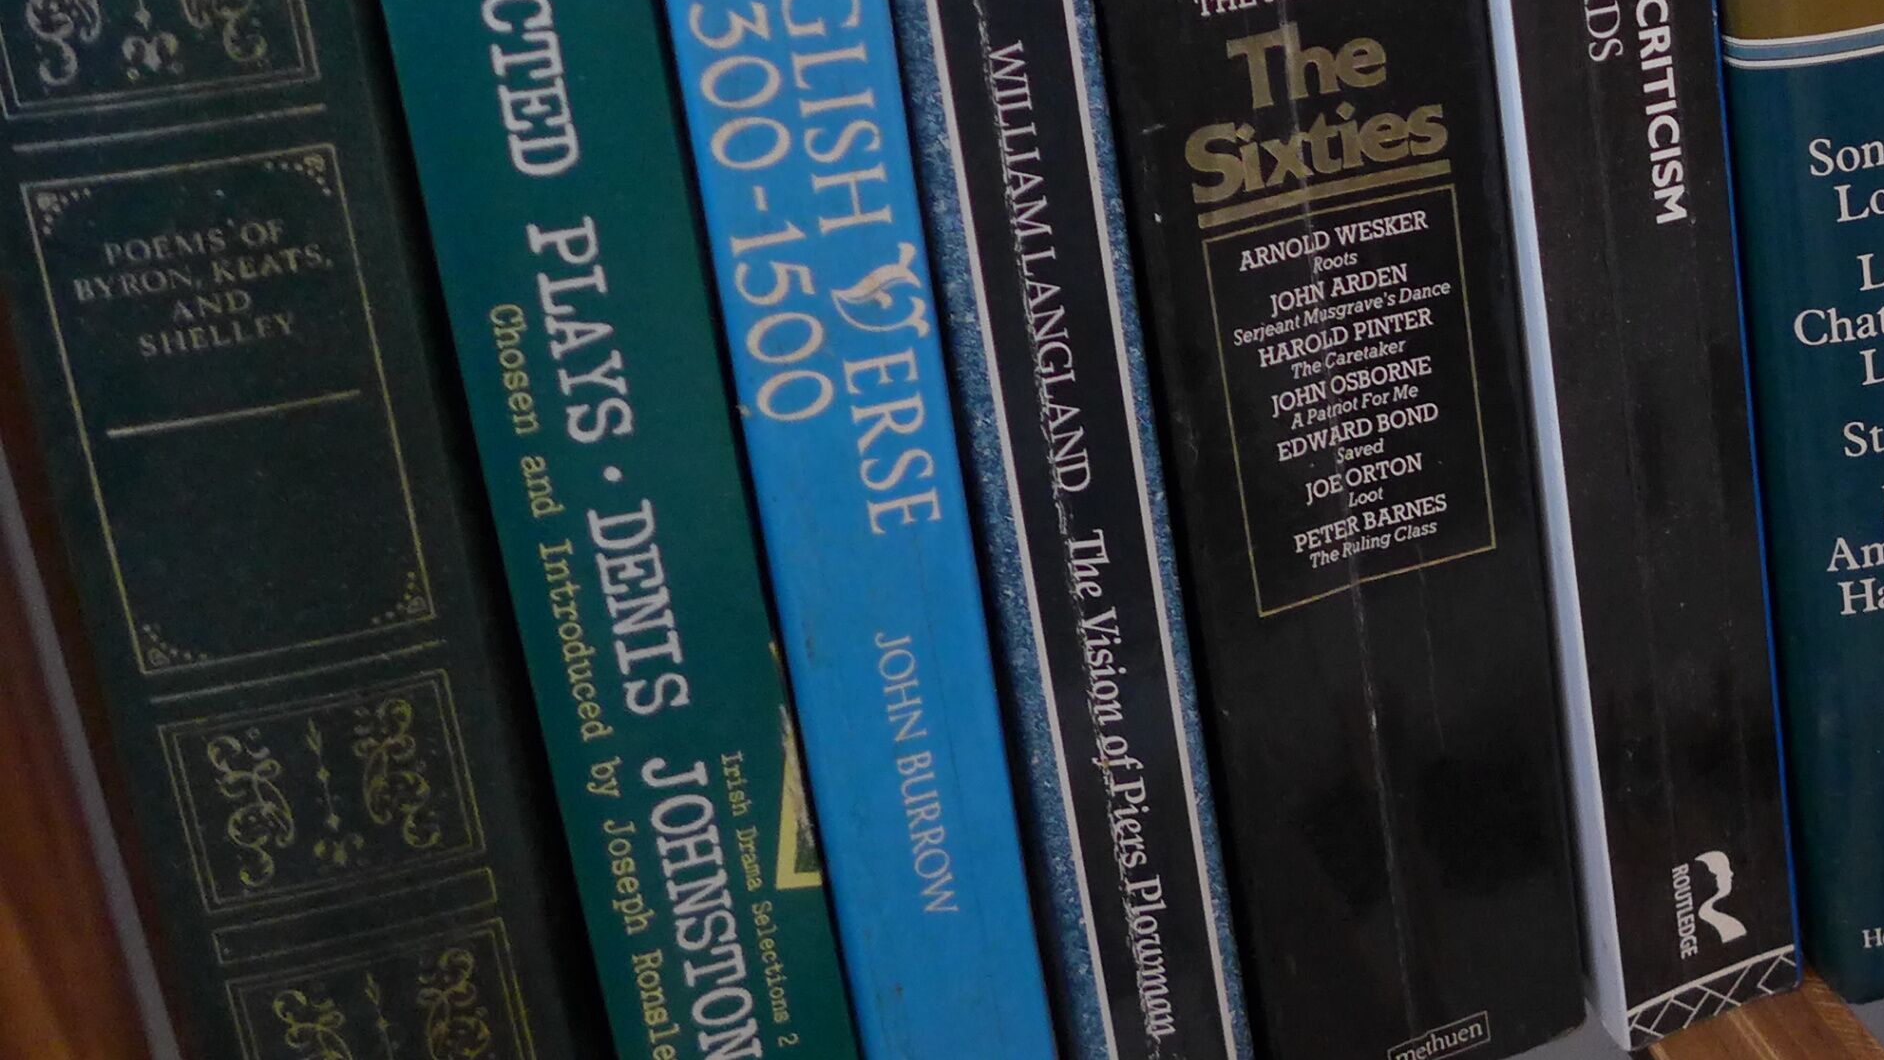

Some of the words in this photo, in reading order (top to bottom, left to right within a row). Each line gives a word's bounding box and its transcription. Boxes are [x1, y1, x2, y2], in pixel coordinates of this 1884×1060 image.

[1226, 21, 1387, 110] The
[987, 39, 1054, 238] WILLIAM
[1185, 102, 1448, 204] Sixties
[104, 227, 226, 266] POEMS
[240, 218, 285, 246] OF
[212, 243, 334, 285] KEATS,
[1239, 230, 1330, 271] ARNOLD
[1335, 210, 1429, 248] WESKER
[1312, 251, 1358, 274] Roots
[173, 289, 251, 323] AND
[1233, 316, 1301, 347] Serjeant
[1303, 290, 1397, 327] Musgrave's
[1399, 281, 1452, 304] Dance
[1270, 284, 1326, 317] JOHN
[1330, 263, 1409, 297] ARDEN
[139, 312, 294, 358] SHELLEY
[1258, 328, 1349, 368] HAROLD
[1354, 307, 1434, 341] PINTER
[1291, 360, 1322, 380] The
[1325, 339, 1406, 369] Caretaker
[489, 303, 541, 437] Chosen
[830, 241, 942, 536] VERSE
[1020, 251, 1092, 494] LANGLAND
[1271, 384, 1327, 417] JOHN
[1330, 356, 1432, 397] OSBORNE
[1277, 417, 1373, 461] EDWARD
[1377, 402, 1439, 434] BOND
[1291, 413, 1304, 430] A
[1307, 399, 1358, 426] Patriot
[1361, 391, 1389, 411] For
[1393, 384, 1419, 400] Me
[1306, 473, 1342, 505] JOE
[1346, 452, 1423, 487] ORTON
[1336, 438, 1384, 464] Saved
[520, 454, 564, 519] and
[1348, 485, 1384, 508] Loot
[1294, 516, 1360, 553] PETER
[1364, 493, 1448, 529] BARNES
[1310, 548, 1340, 569] The
[1342, 532, 1392, 559] Ruling
[1394, 521, 1437, 542] Class
[1067, 528, 1110, 599] The
[527, 216, 633, 444] PLAYS
[587, 498, 690, 715] DENIS
[641, 756, 763, 1060] JOHNSTON
[539, 538, 614, 743] Introduced
[1085, 606, 1127, 727] Vision
[873, 631, 928, 745] JOHN
[586, 755, 622, 797] by
[720, 750, 753, 817] Irish
[1097, 736, 1144, 773] of
[896, 750, 960, 919] BURROW
[1110, 778, 1149, 869] Piers
[603, 818, 656, 936] Joseph
[736, 825, 763, 892] Drama
[1671, 863, 1698, 960] ROUTLEDGE
[751, 900, 790, 1024] Selections
[1125, 874, 1177, 1039] Plowman
[777, 1033, 799, 1048] 2
